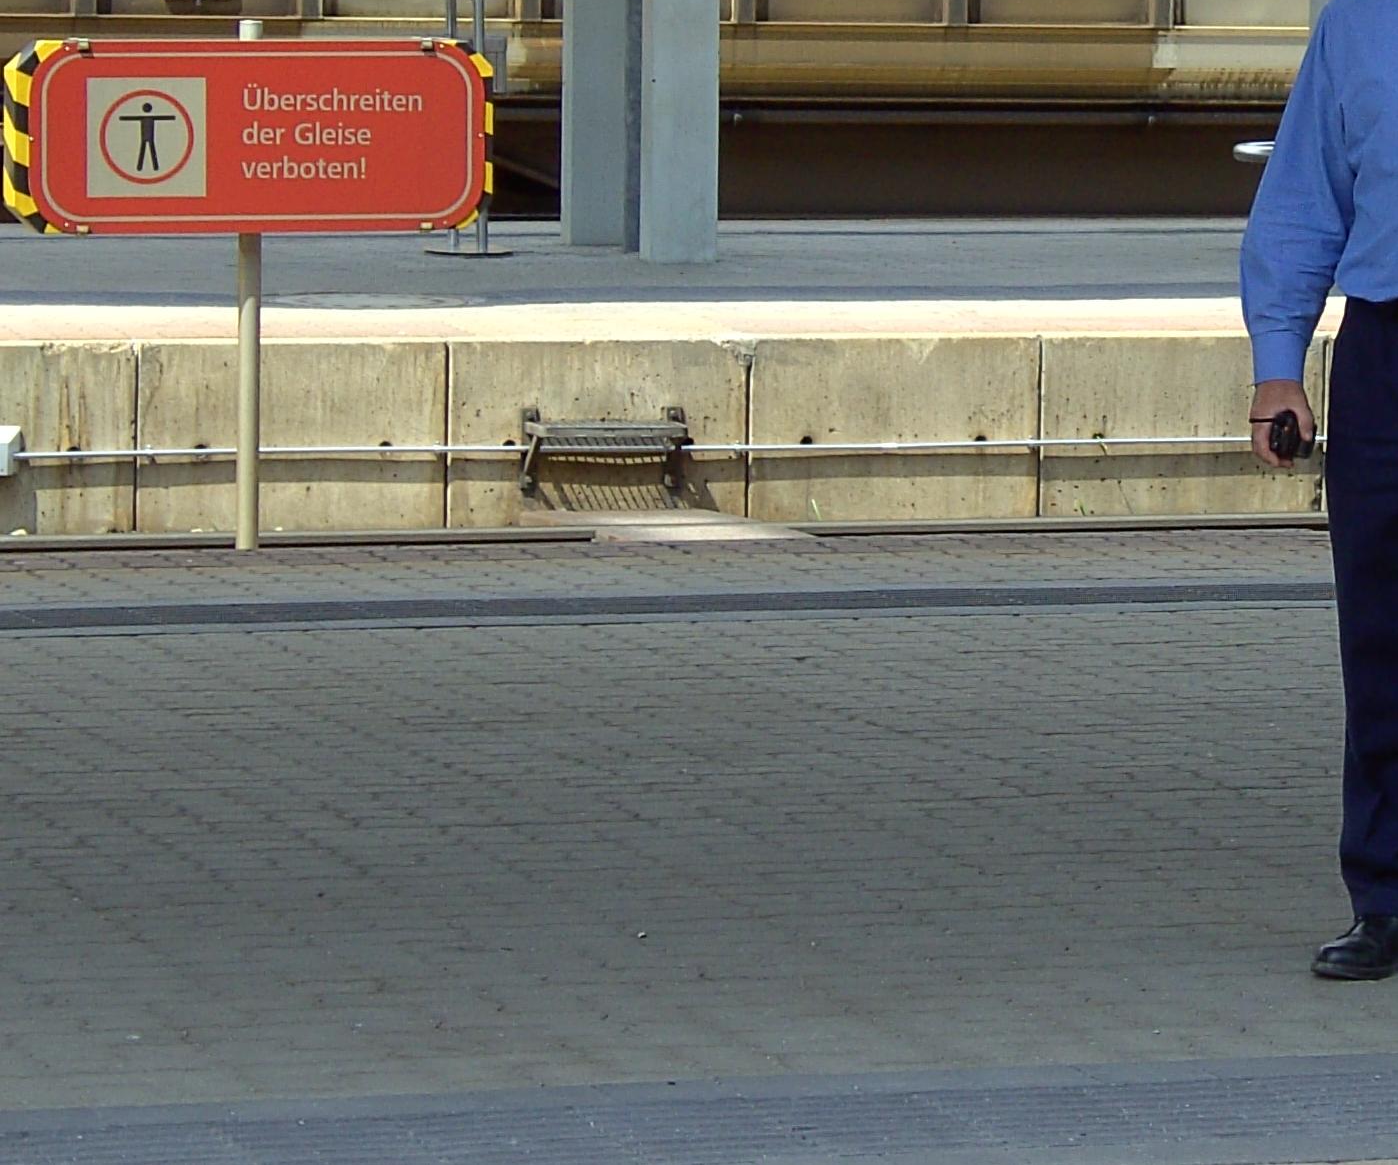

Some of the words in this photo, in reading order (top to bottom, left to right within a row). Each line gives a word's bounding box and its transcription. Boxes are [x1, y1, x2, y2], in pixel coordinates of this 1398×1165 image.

[242, 83, 423, 112] Überschreiten
[242, 121, 286, 145] der
[294, 121, 372, 145] Gleise
[241, 155, 367, 179] verboten!
